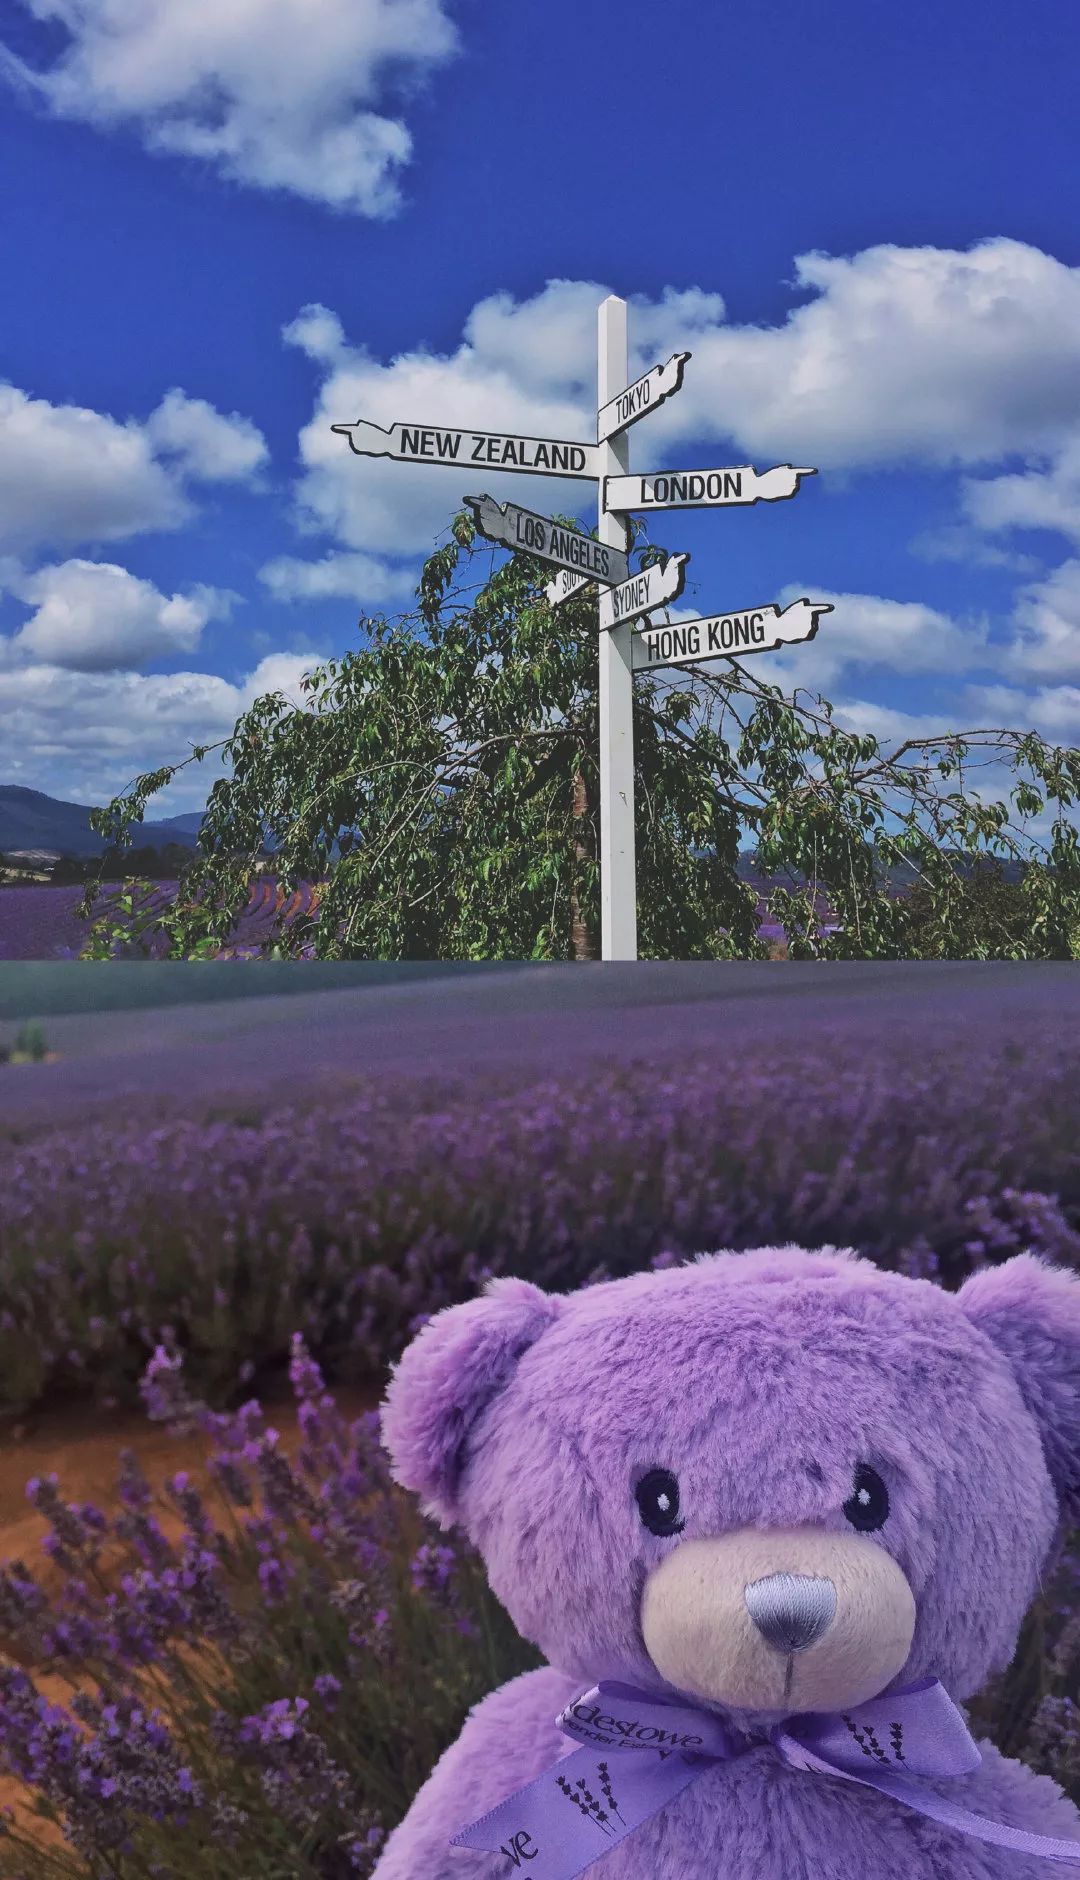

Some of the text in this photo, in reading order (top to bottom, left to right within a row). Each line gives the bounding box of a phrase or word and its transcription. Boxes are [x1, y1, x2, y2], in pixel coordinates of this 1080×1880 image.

[615, 379, 650, 424] TOKYO
[400, 428, 586, 471] NEW ZEALAND
[640, 472, 742, 504] LONDON
[516, 512, 610, 577] LOS ANGELES
[613, 574, 650, 618] SYDNEY
[648, 613, 765, 661] HONG KONG
[570, 1702, 703, 1748] destowe
